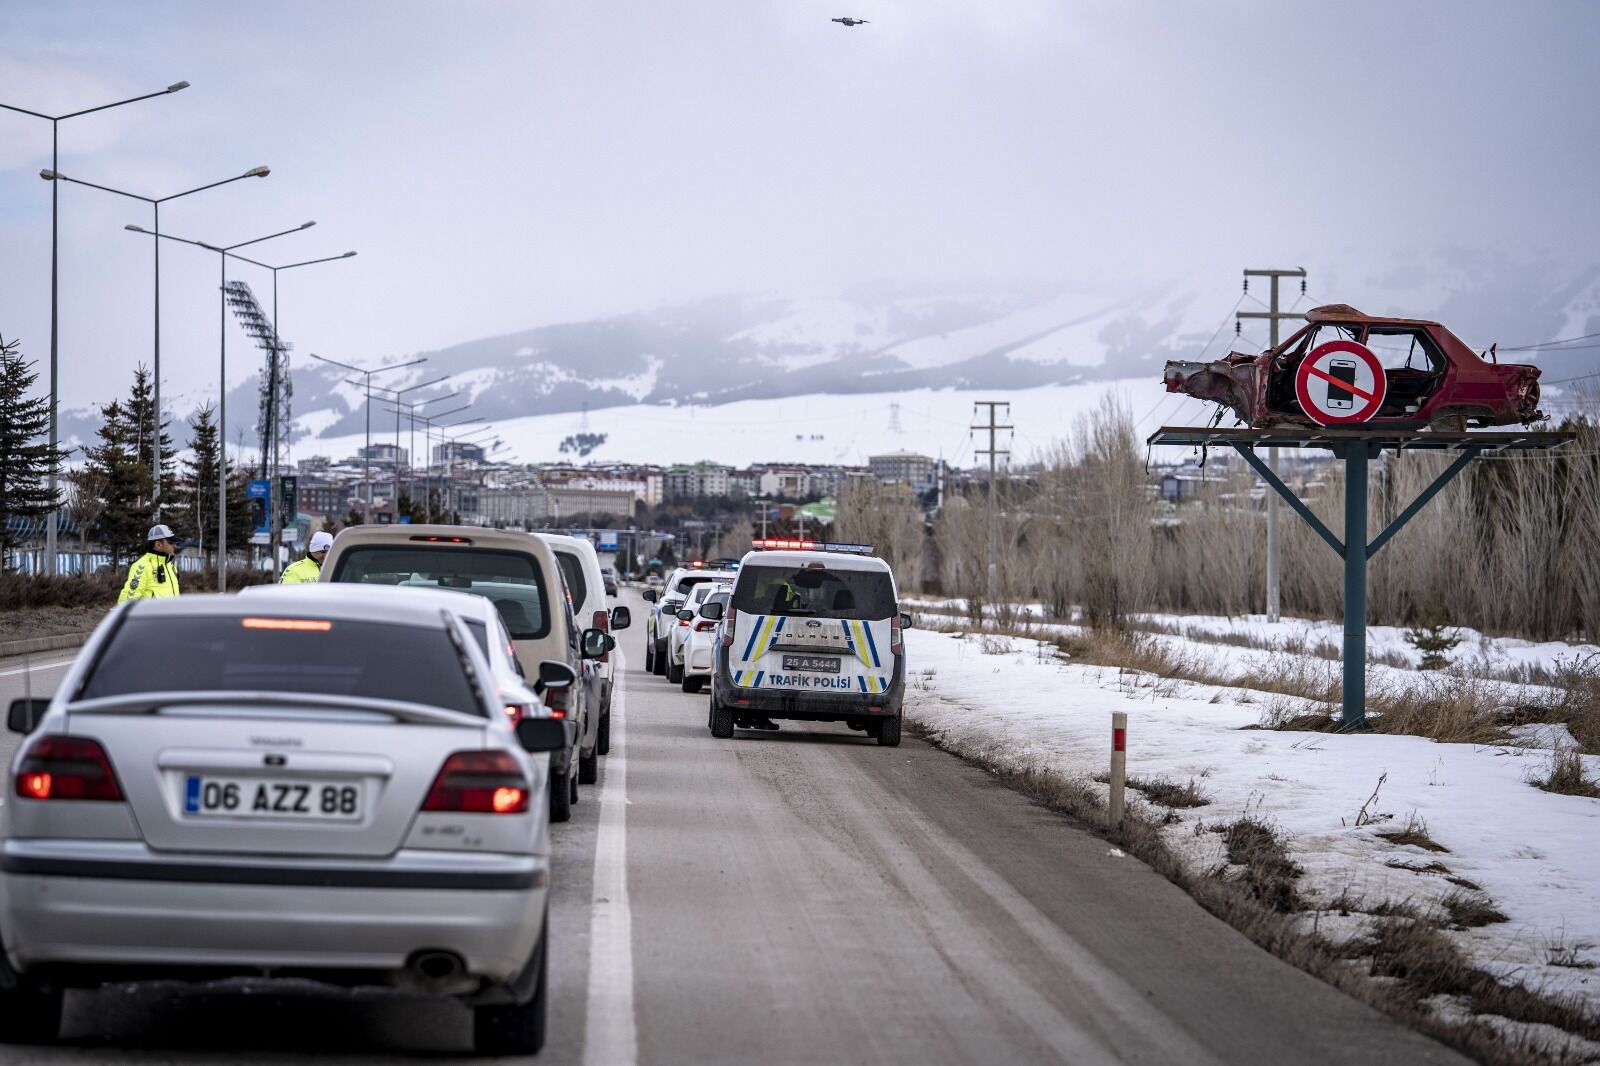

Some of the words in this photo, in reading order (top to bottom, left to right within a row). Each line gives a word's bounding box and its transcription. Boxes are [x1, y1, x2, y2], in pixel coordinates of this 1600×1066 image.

[786, 658, 799, 666] 25
[801, 659, 810, 667] A
[812, 660, 836, 668] 5444
[769, 674, 809, 686] TRAFİK
[814, 676, 850, 688] POLİSİ
[203, 782, 240, 810] 06
[253, 784, 310, 812] AZZ
[320, 786, 357, 814] 88
